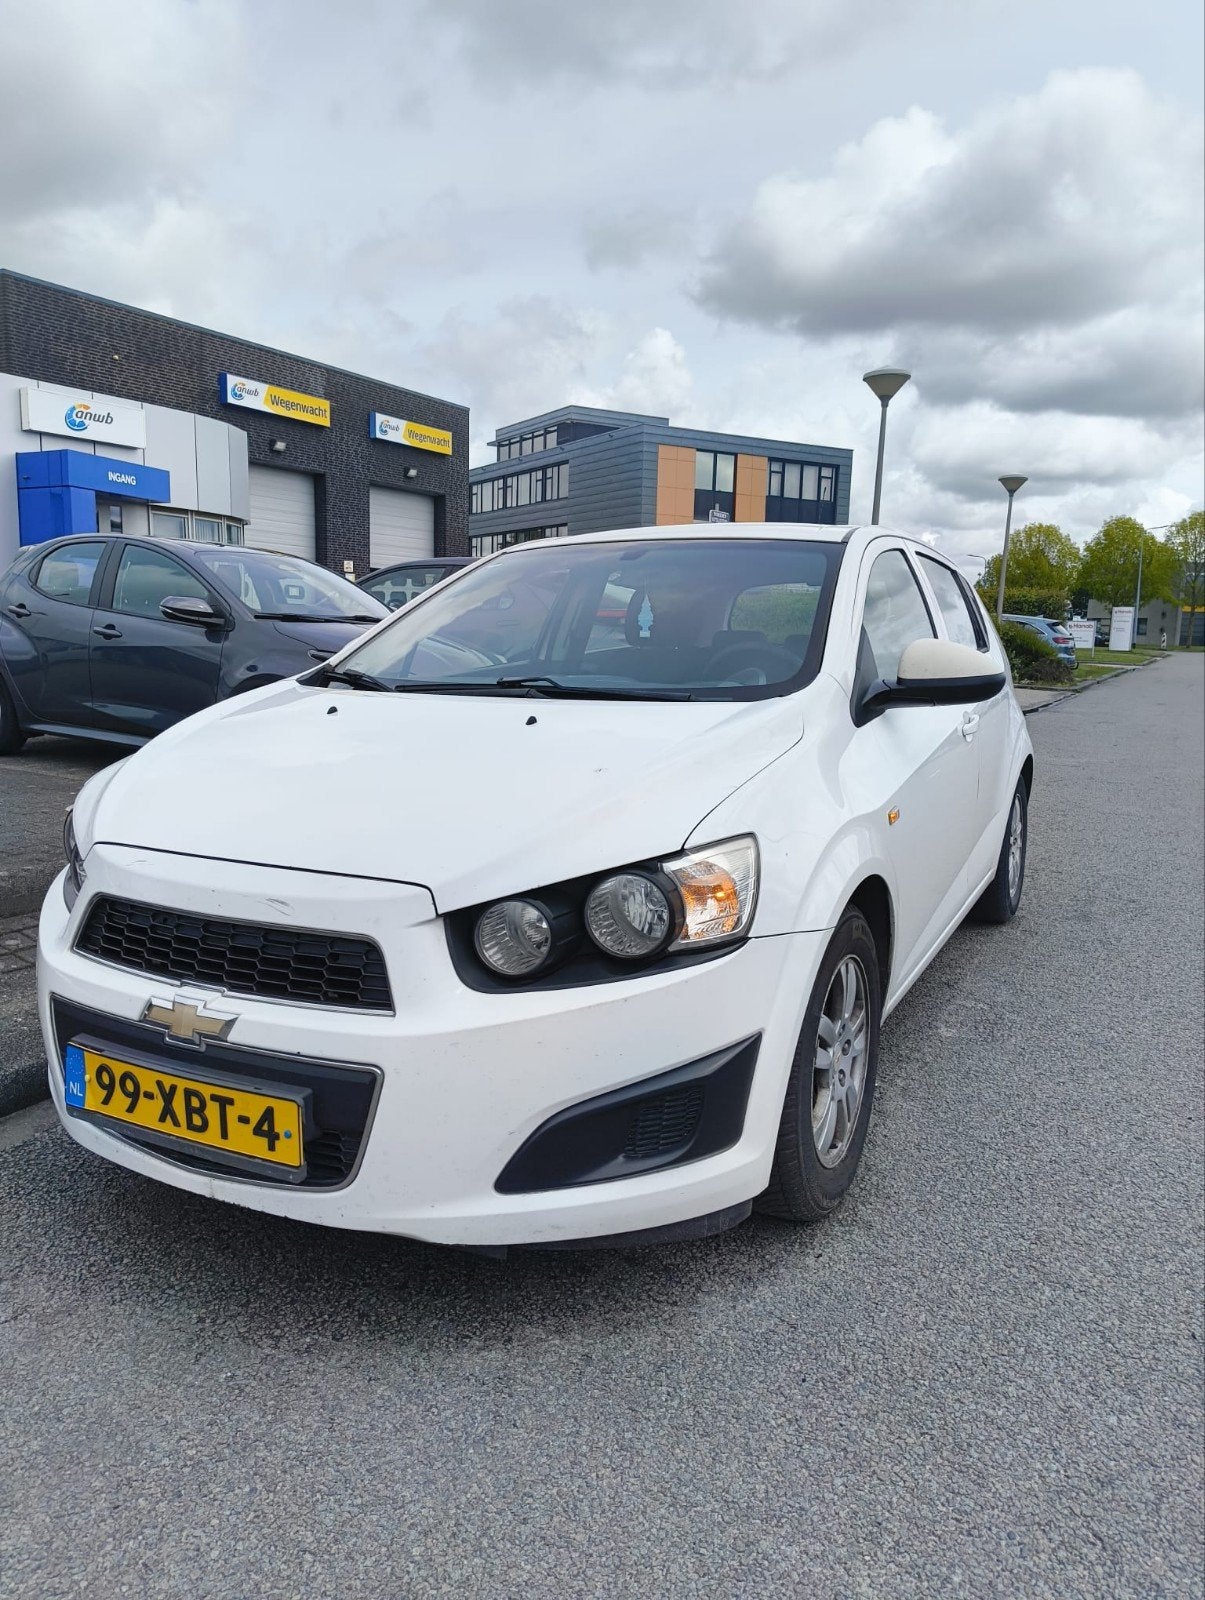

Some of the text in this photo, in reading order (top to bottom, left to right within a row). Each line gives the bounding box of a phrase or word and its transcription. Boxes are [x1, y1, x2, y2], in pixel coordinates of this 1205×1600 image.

[236, 386, 328, 419] anwb Wegenwacht
[75, 409, 114, 425] anwb
[407, 428, 450, 448] Wegenwacht
[108, 471, 137, 485] INGANG
[69, 1080, 84, 1097] NL
[95, 1062, 280, 1152] 99-XBT-4
